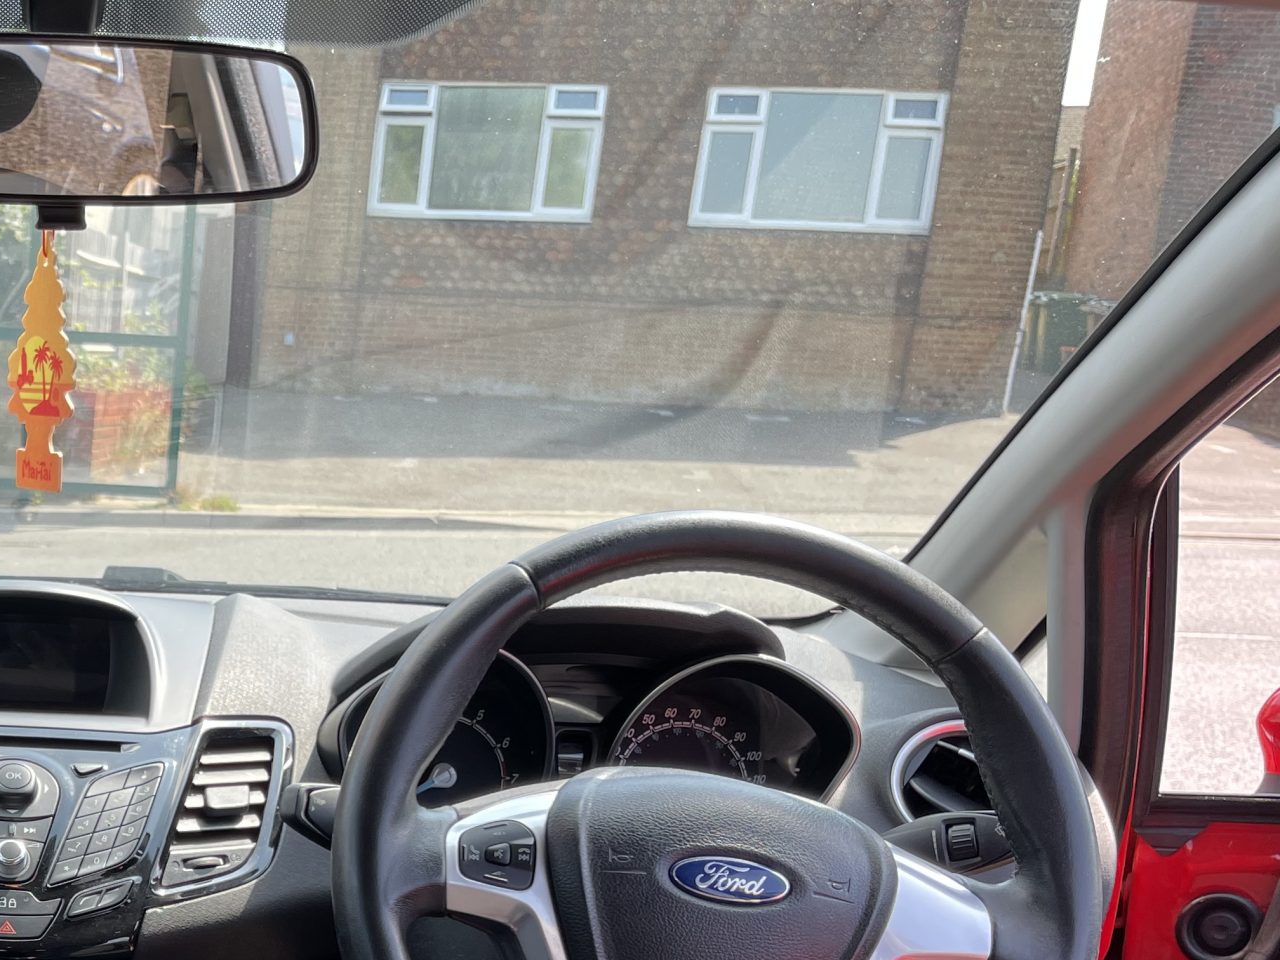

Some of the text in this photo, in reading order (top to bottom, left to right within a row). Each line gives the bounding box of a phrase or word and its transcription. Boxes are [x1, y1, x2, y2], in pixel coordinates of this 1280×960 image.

[476, 709, 485, 721] 5
[664, 707, 677, 718] 60
[688, 709, 702, 719] 70
[642, 714, 655, 725] 50
[713, 716, 726, 727] 80
[733, 731, 747, 742] 90
[502, 737, 511, 749] 6
[746, 751, 762, 761] 100
[5, 771, 22, 780] OK
[510, 773, 520, 785] 7
[752, 774, 767, 785] 110
[695, 861, 767, 896] Ford
